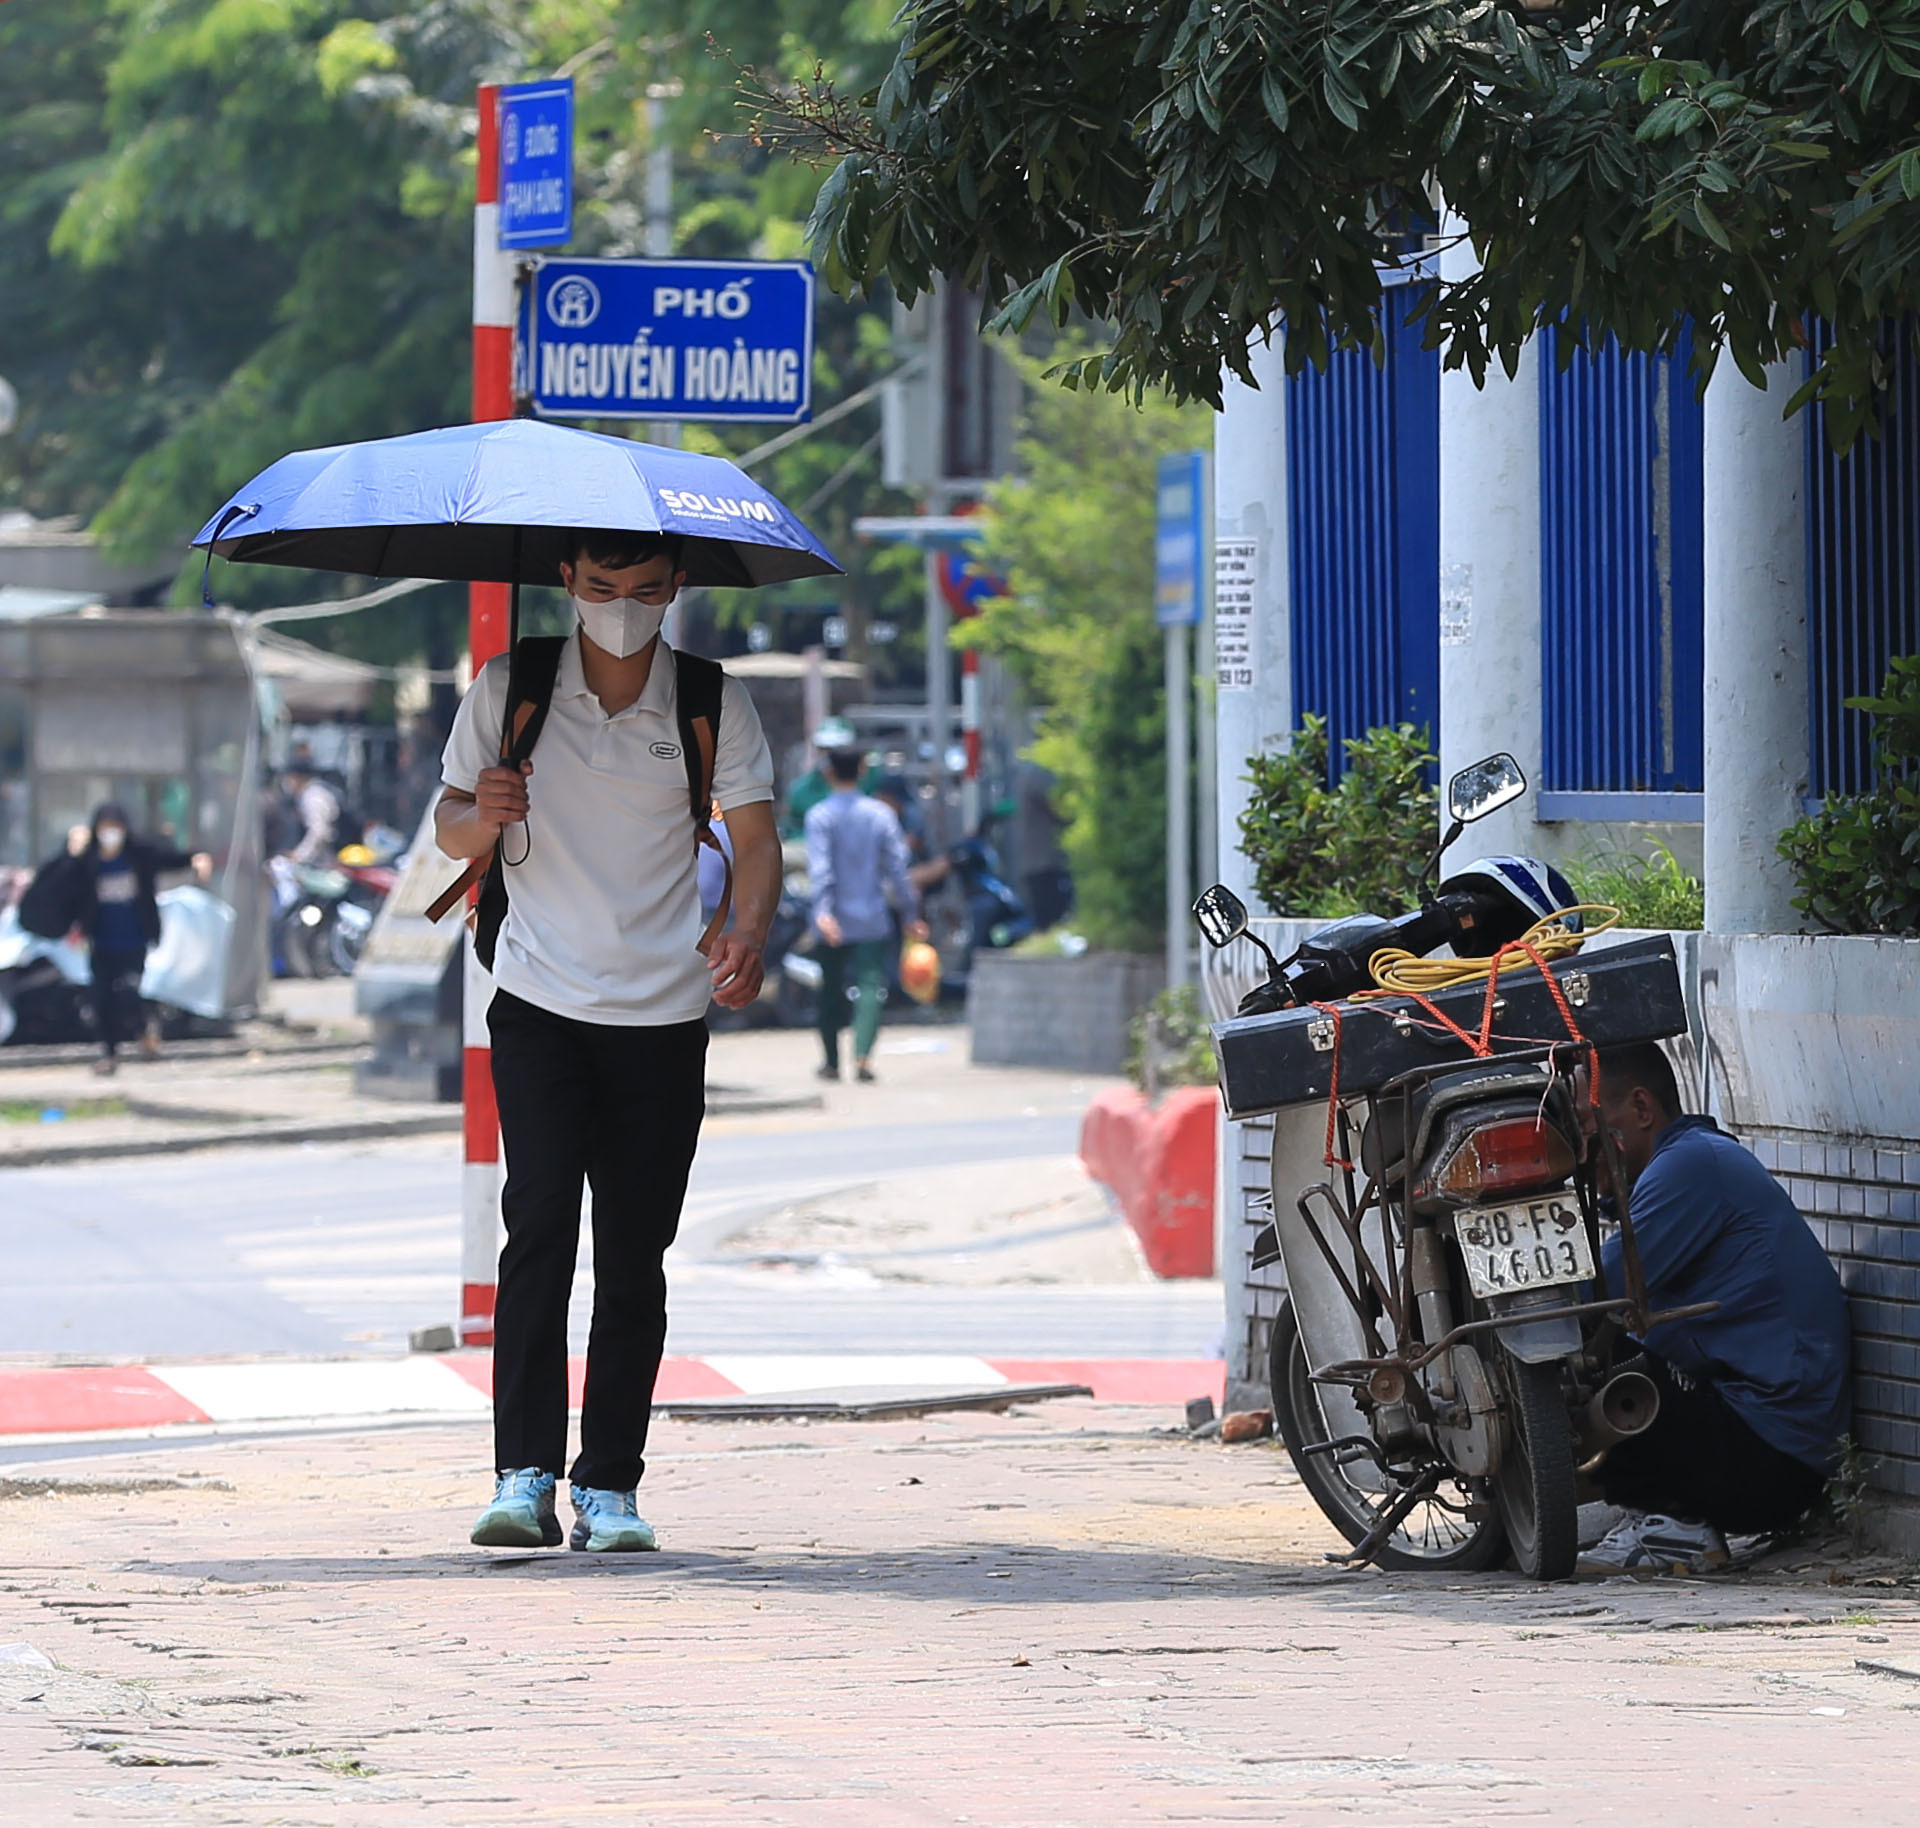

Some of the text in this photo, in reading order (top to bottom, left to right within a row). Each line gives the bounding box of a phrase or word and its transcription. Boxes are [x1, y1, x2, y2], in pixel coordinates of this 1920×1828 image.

[653, 277, 754, 319] PHỐ
[541, 326, 675, 400] NGUYỄN
[684, 337, 800, 403] HOÀNG
[658, 488, 775, 522] SOLUM
[1488, 1241, 1578, 1288] 4603
